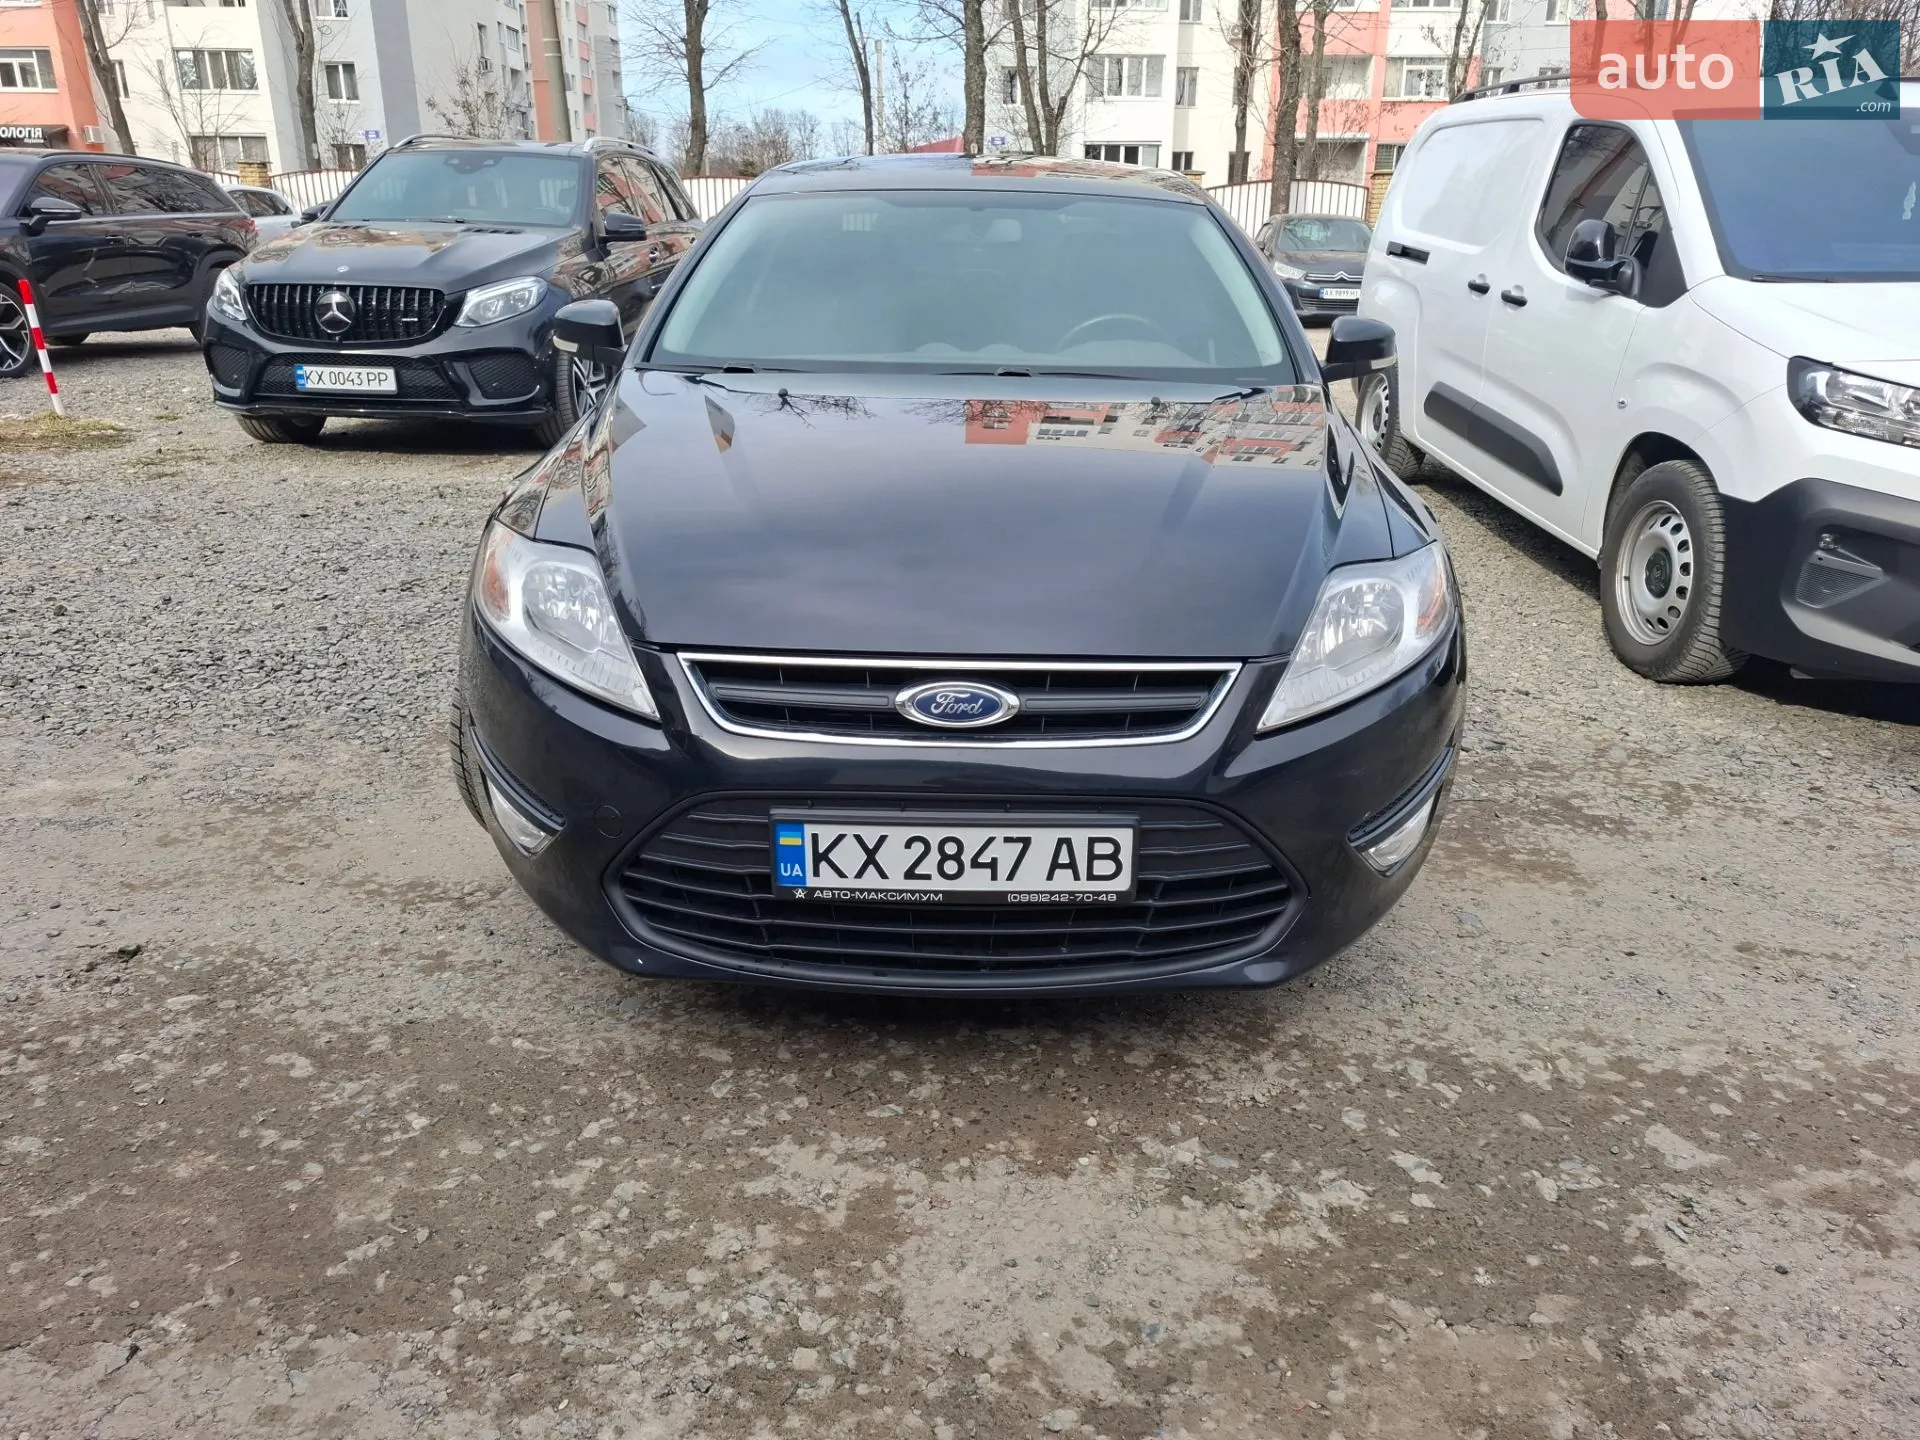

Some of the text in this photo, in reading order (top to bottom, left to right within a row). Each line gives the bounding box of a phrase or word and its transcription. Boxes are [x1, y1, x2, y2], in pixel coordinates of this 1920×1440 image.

[304, 370, 388, 386] KX 0043 PP
[930, 692, 984, 714] Ford
[810, 832, 1124, 882] KX 2847 AB
[780, 864, 803, 877] UA
[813, 890, 943, 901] АВТО-МАКСИМУМ
[1007, 893, 1117, 903] (099)242-70-48
